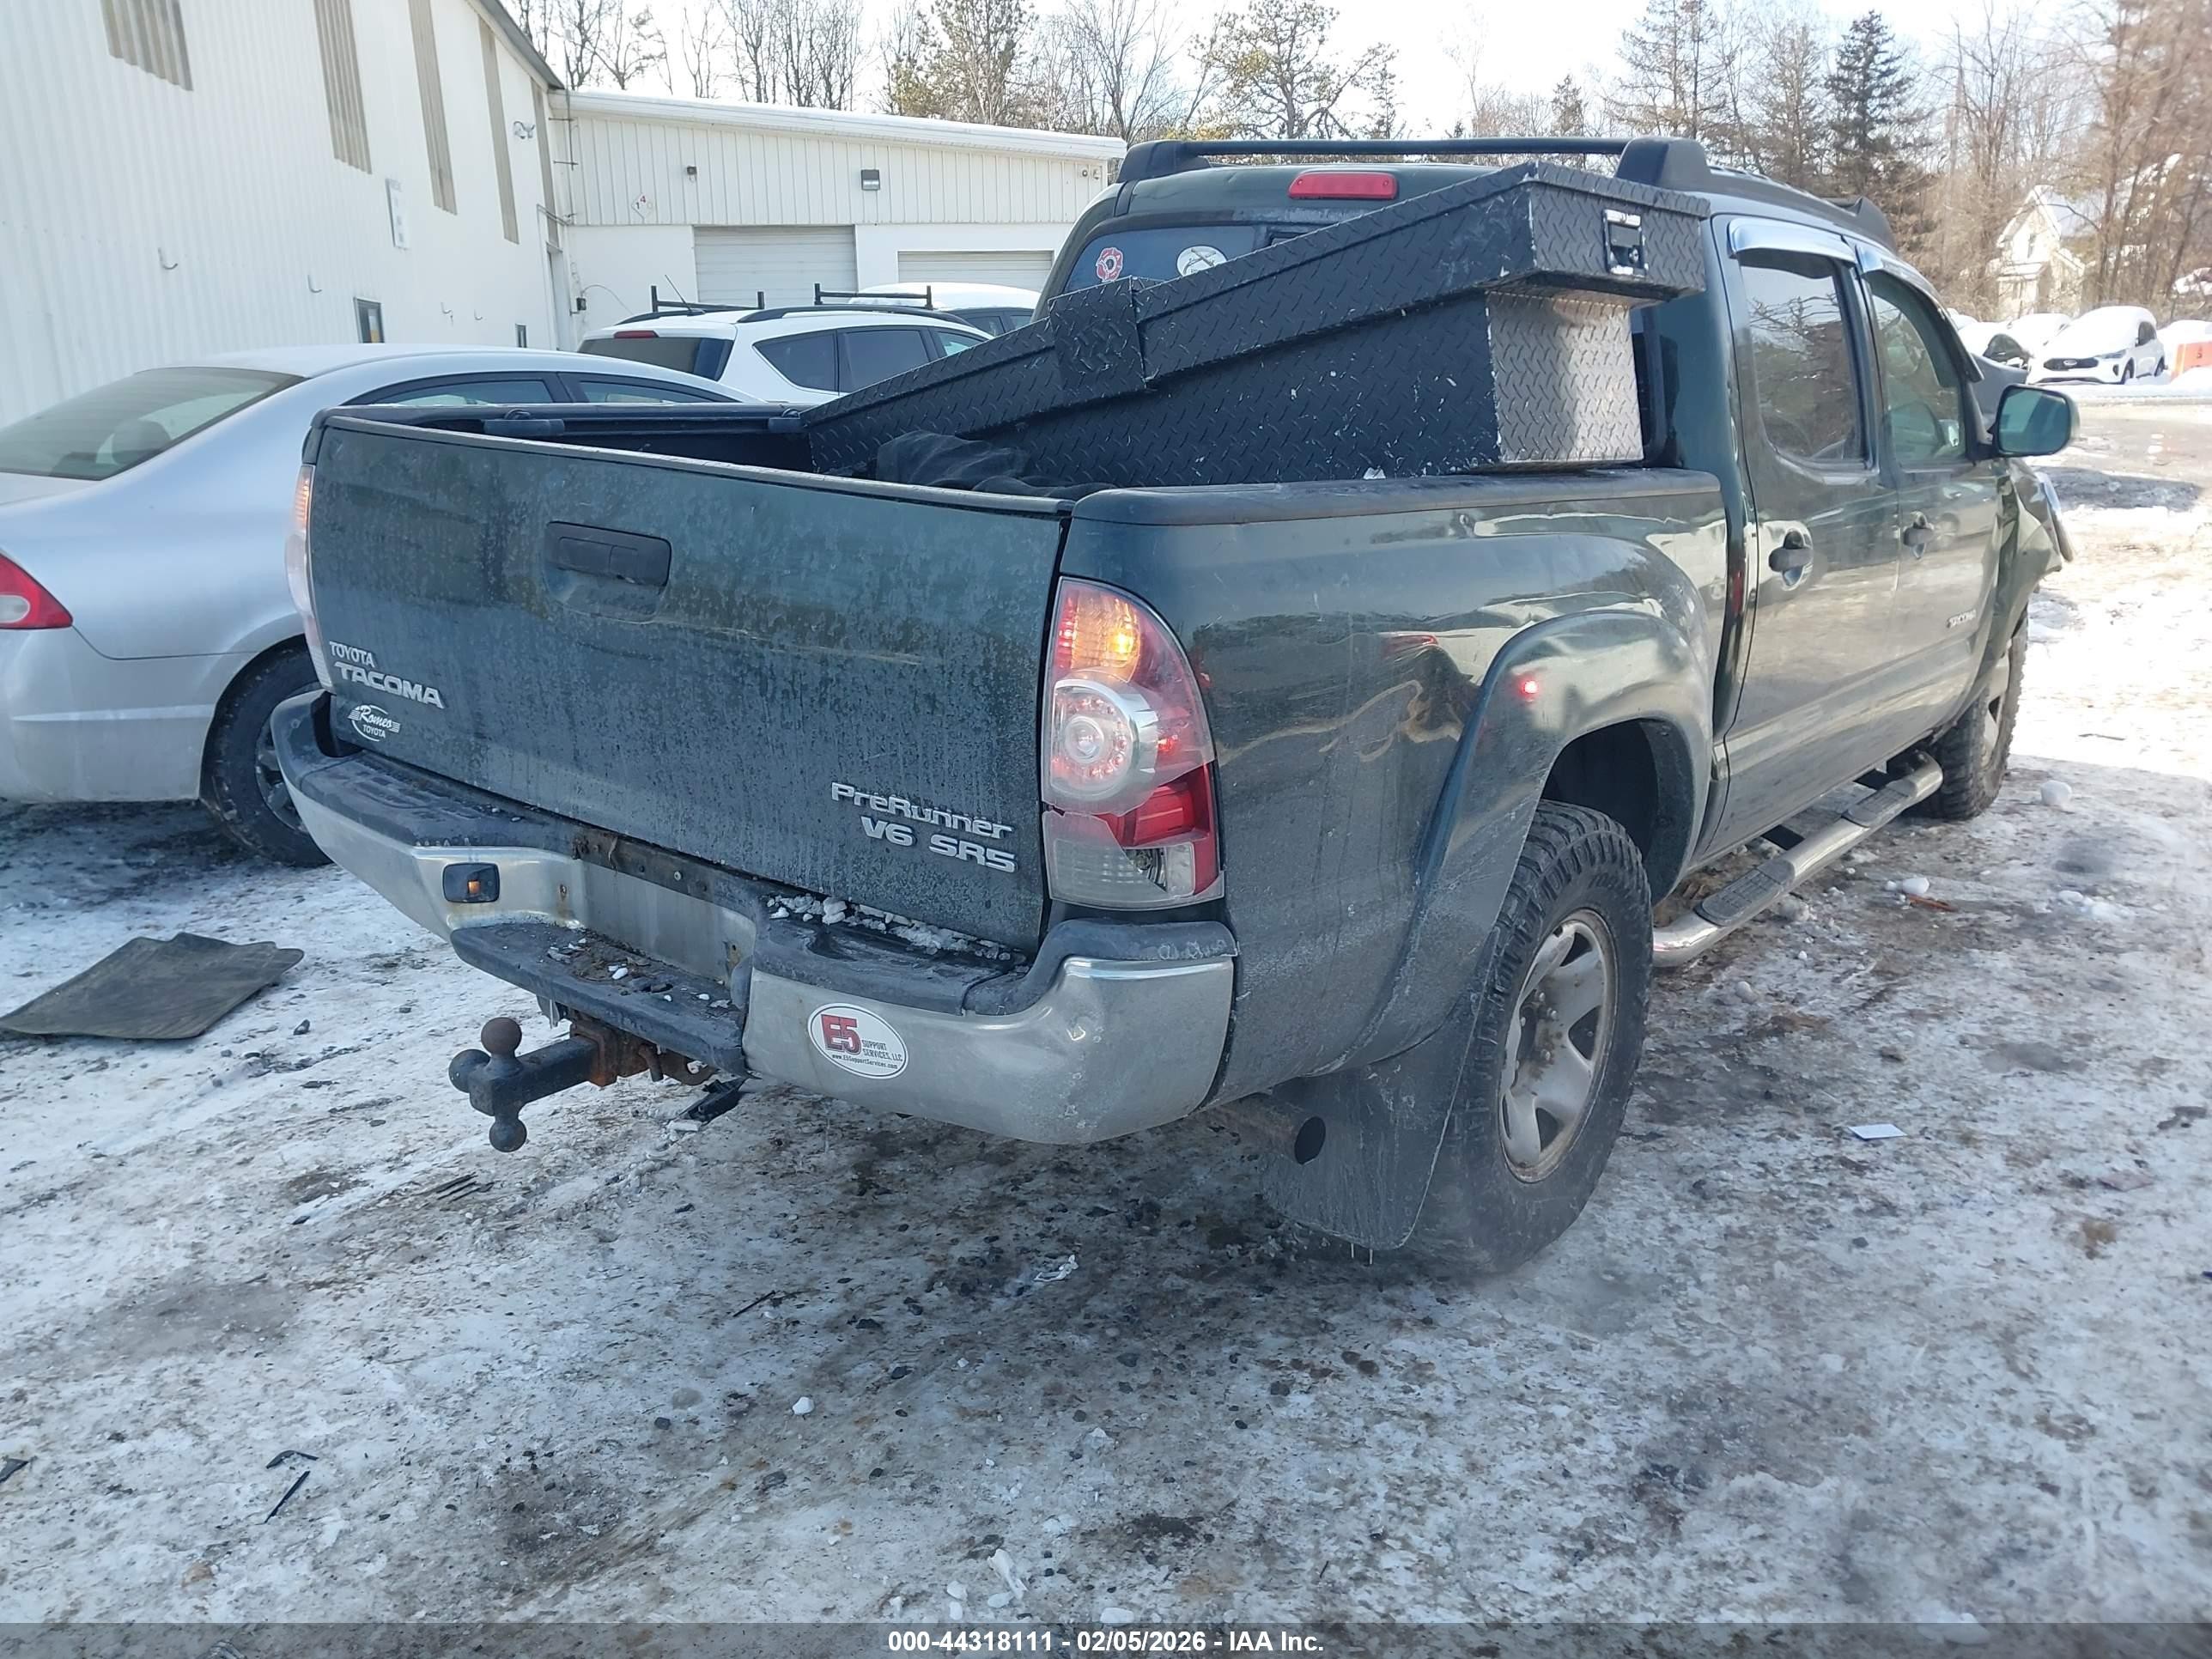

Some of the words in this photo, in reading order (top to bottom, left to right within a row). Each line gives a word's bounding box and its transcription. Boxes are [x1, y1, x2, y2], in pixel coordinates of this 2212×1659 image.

[640, 195, 646, 204] 4
[329, 641, 376, 668] TOYOTA
[334, 661, 446, 709] TACOMA
[359, 704, 392, 729] Romeo
[362, 724, 386, 738] TOYOTA
[831, 781, 1013, 840] PreRunner
[860, 816, 915, 848] V6
[928, 834, 1017, 874] SR5
[821, 1013, 861, 1055] E5
[861, 1039, 887, 1050] SUPPORT
